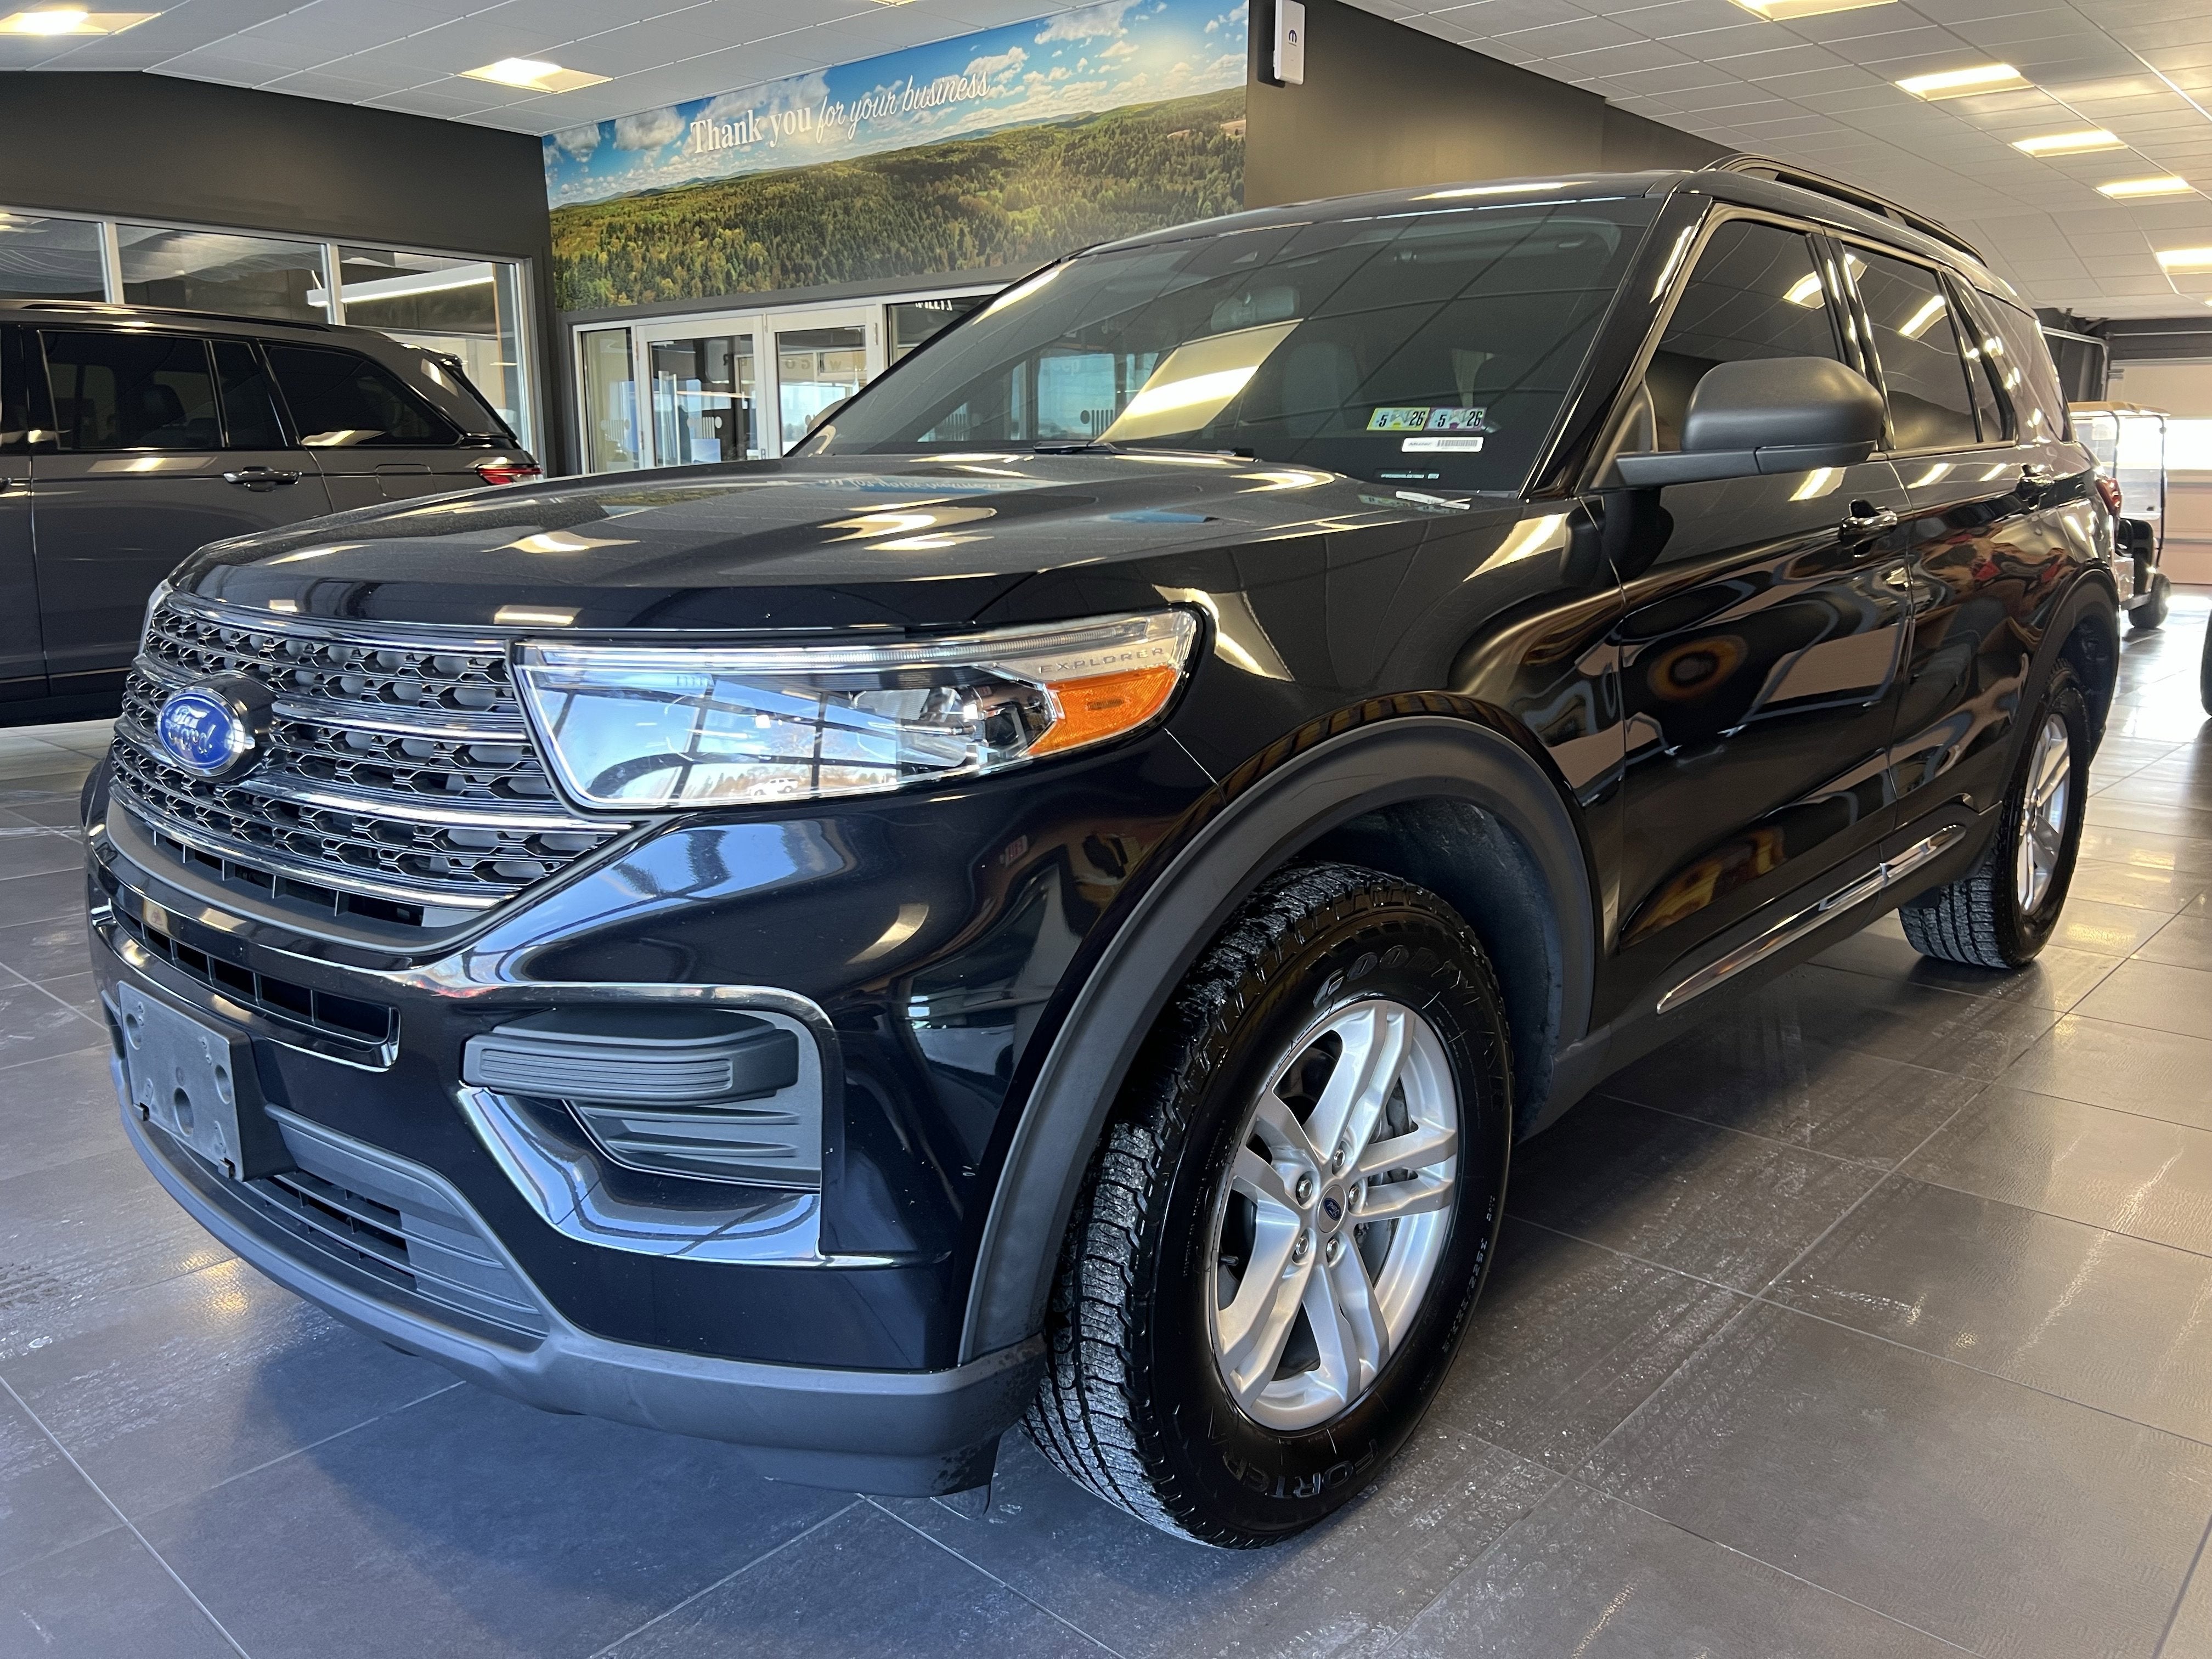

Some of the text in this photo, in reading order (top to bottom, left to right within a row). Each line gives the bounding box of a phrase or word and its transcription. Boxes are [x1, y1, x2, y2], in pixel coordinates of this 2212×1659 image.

[690, 70, 991, 154] Thank you for your business
[1378, 411, 1426, 427] 5 26
[1437, 411, 1483, 427] 5 26
[1039, 647, 1164, 674] EXPLORER
[1327, 1201, 1340, 1217] Ford
